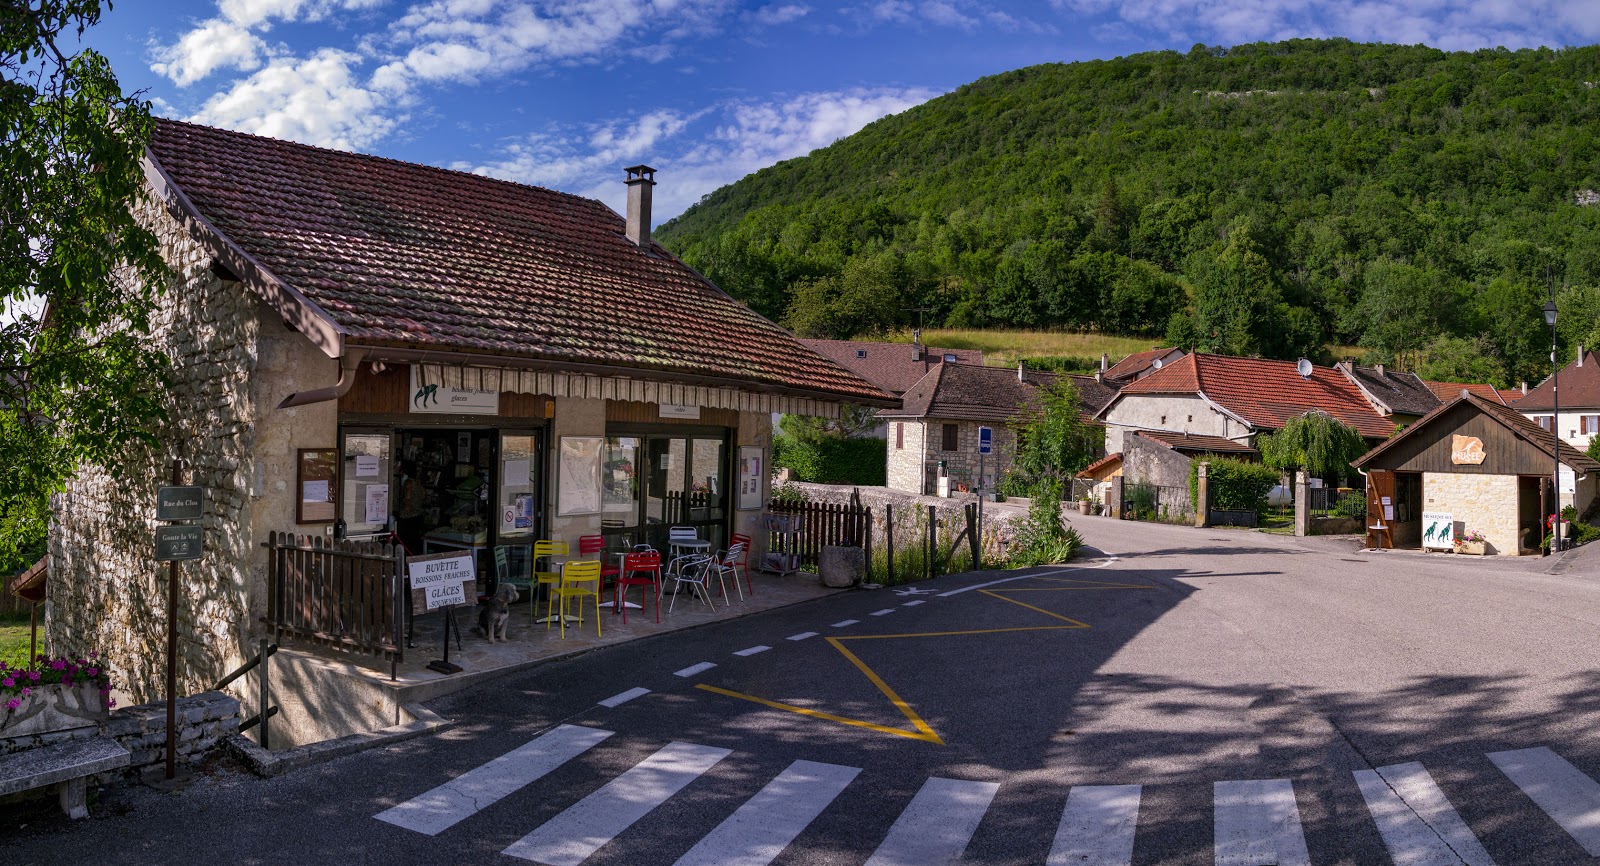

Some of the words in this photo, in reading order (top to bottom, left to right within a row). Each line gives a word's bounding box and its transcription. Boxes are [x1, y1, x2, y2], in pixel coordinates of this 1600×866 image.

[425, 561, 459, 573] BUVETTE
[415, 574, 442, 584] BOISSONS
[444, 570, 471, 580] FRAICHES
[431, 597, 461, 607] SOUVENIRS
